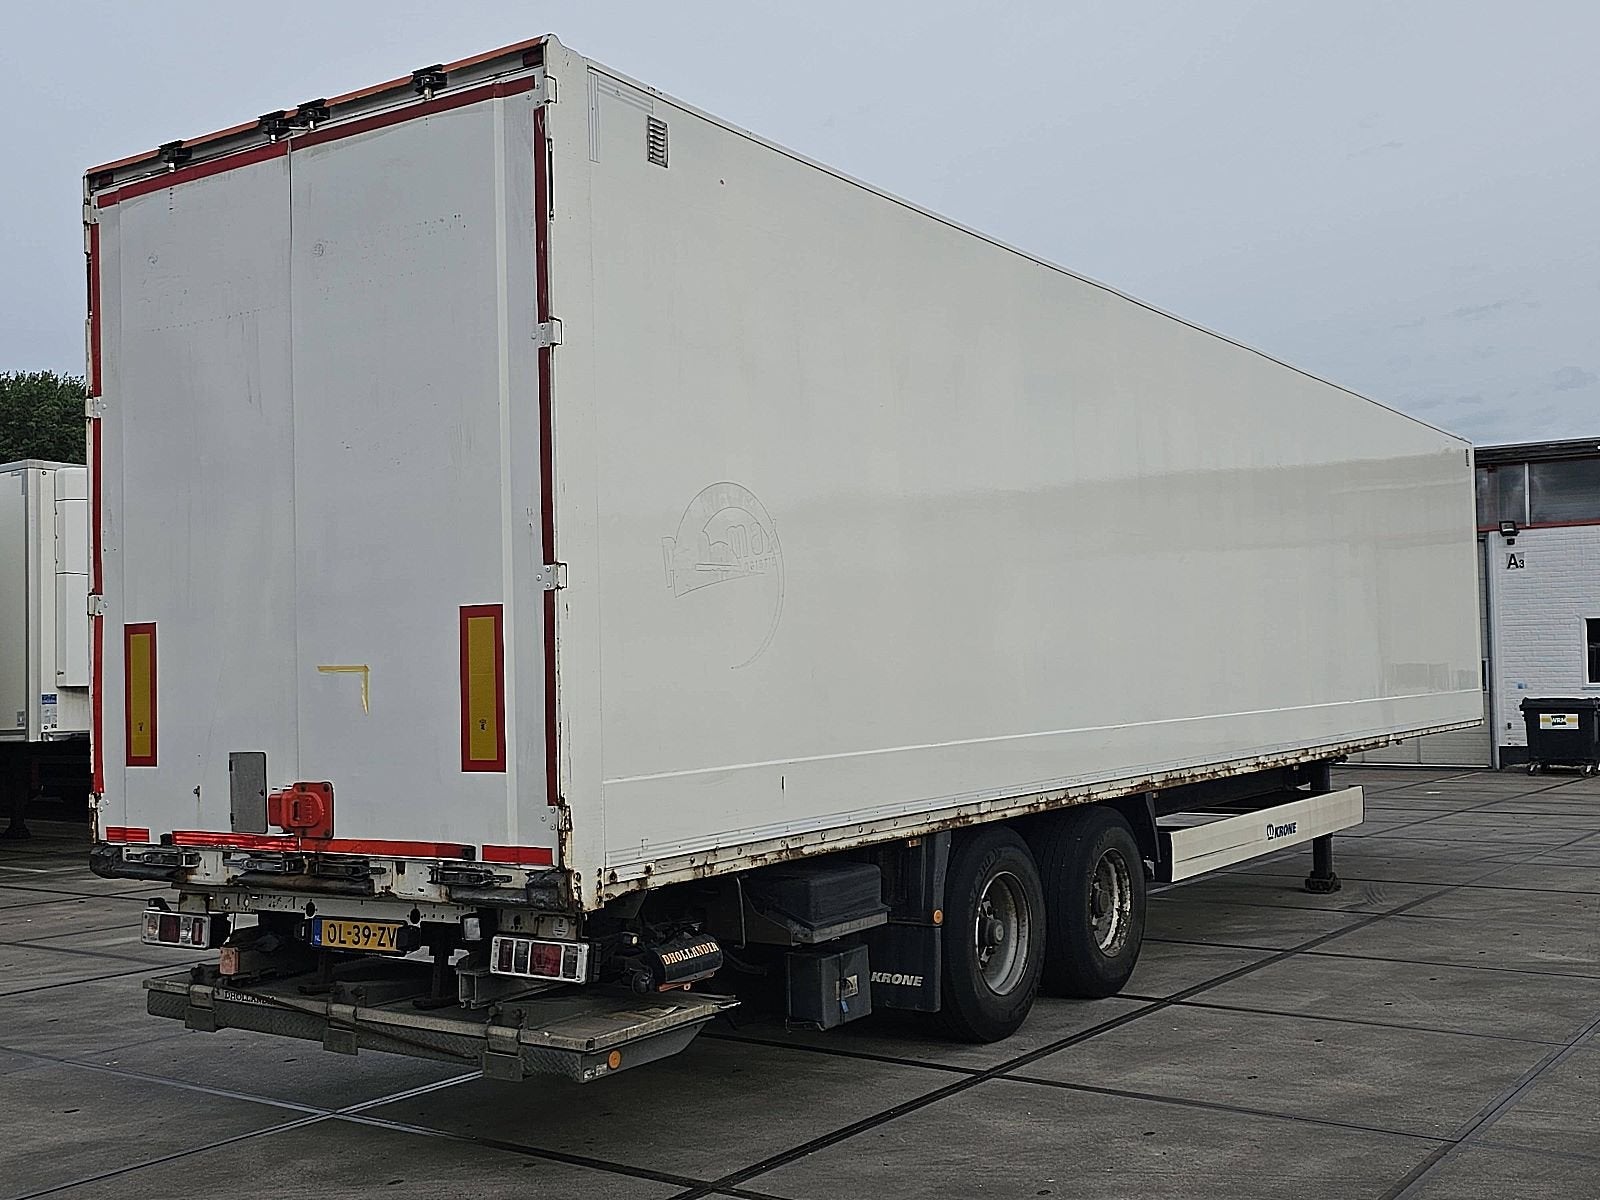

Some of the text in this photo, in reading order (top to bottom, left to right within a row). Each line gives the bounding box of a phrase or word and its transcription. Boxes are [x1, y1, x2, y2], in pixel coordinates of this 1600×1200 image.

[1274, 821, 1297, 839] KRONE
[327, 923, 397, 948] OL-39-ZV
[661, 941, 720, 966] DHOLLANDIA
[870, 971, 924, 987] KRONE
